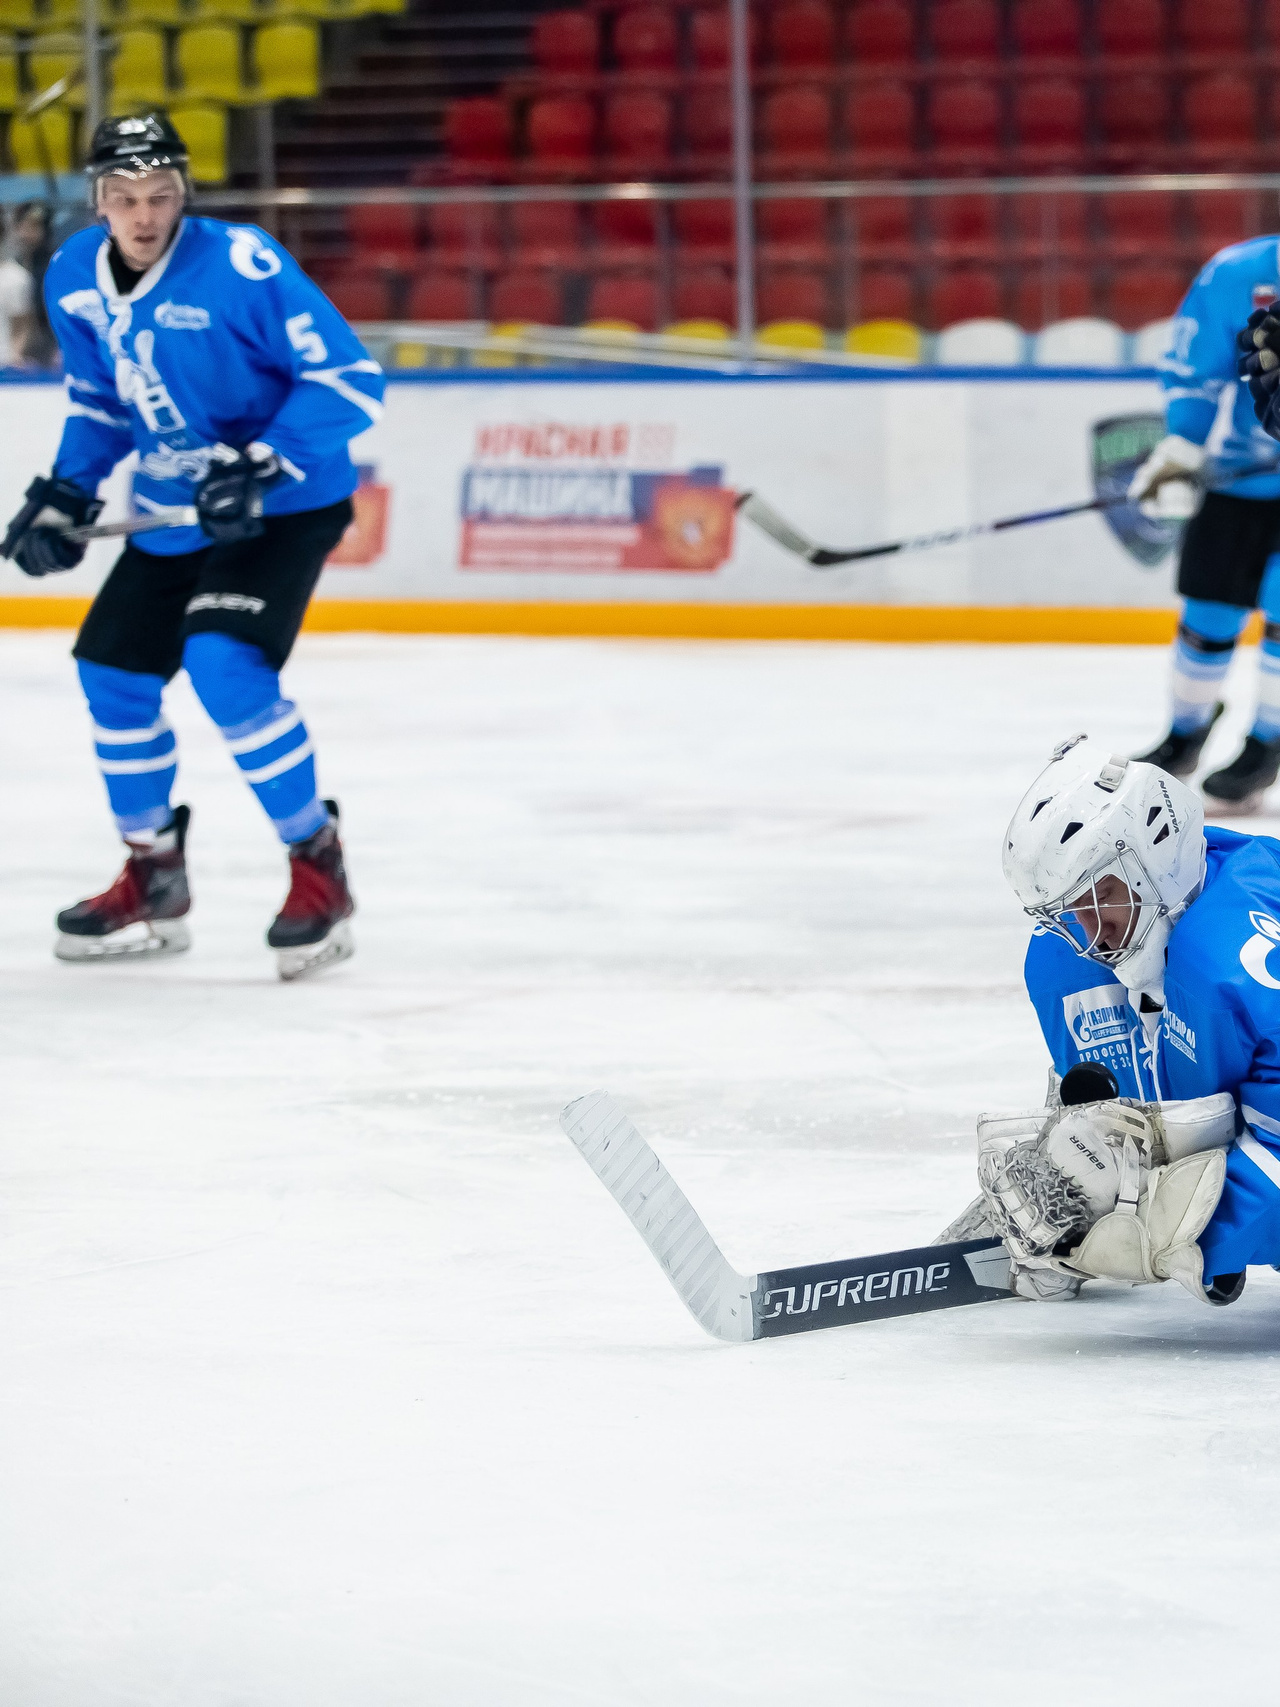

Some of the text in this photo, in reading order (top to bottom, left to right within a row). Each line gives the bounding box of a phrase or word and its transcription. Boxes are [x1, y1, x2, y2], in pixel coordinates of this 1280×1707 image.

[285, 312, 328, 364] 5
[1157, 779, 1180, 834] VAUGHN
[1069, 1135, 1105, 1170] BAUER
[761, 1262, 951, 1321] SUPREME
